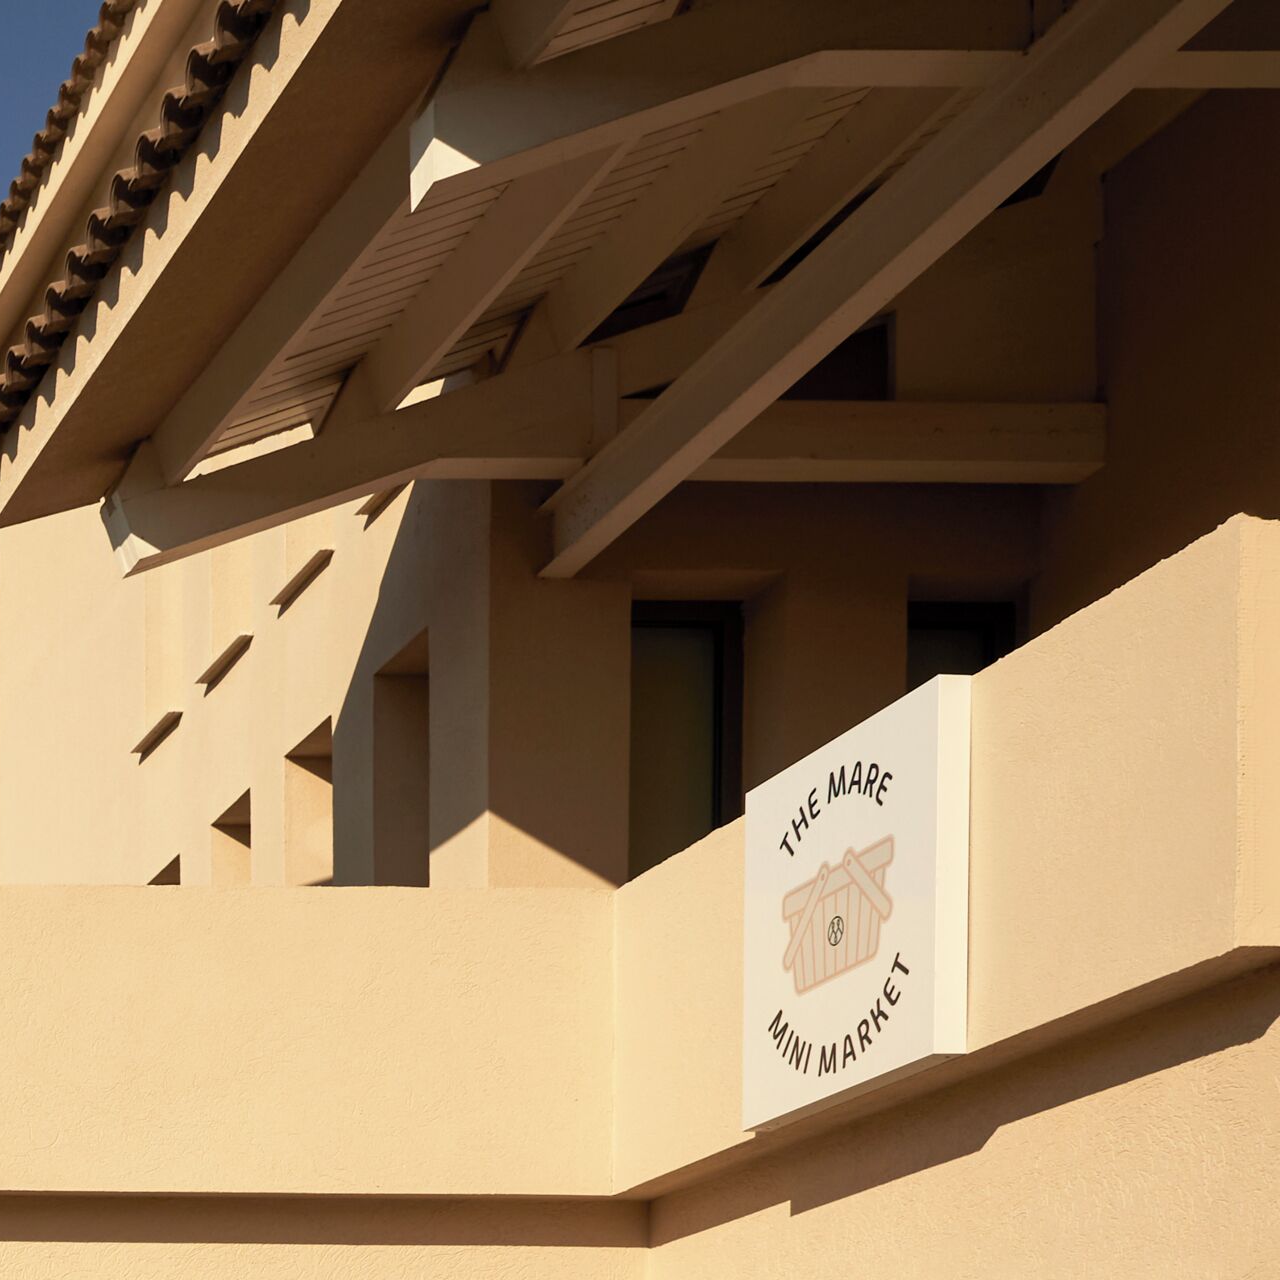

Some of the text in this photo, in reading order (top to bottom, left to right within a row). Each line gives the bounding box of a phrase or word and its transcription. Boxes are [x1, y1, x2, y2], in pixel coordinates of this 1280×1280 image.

[779, 760, 893, 857] THE MARE
[767, 952, 910, 1077] MINI MARKET
